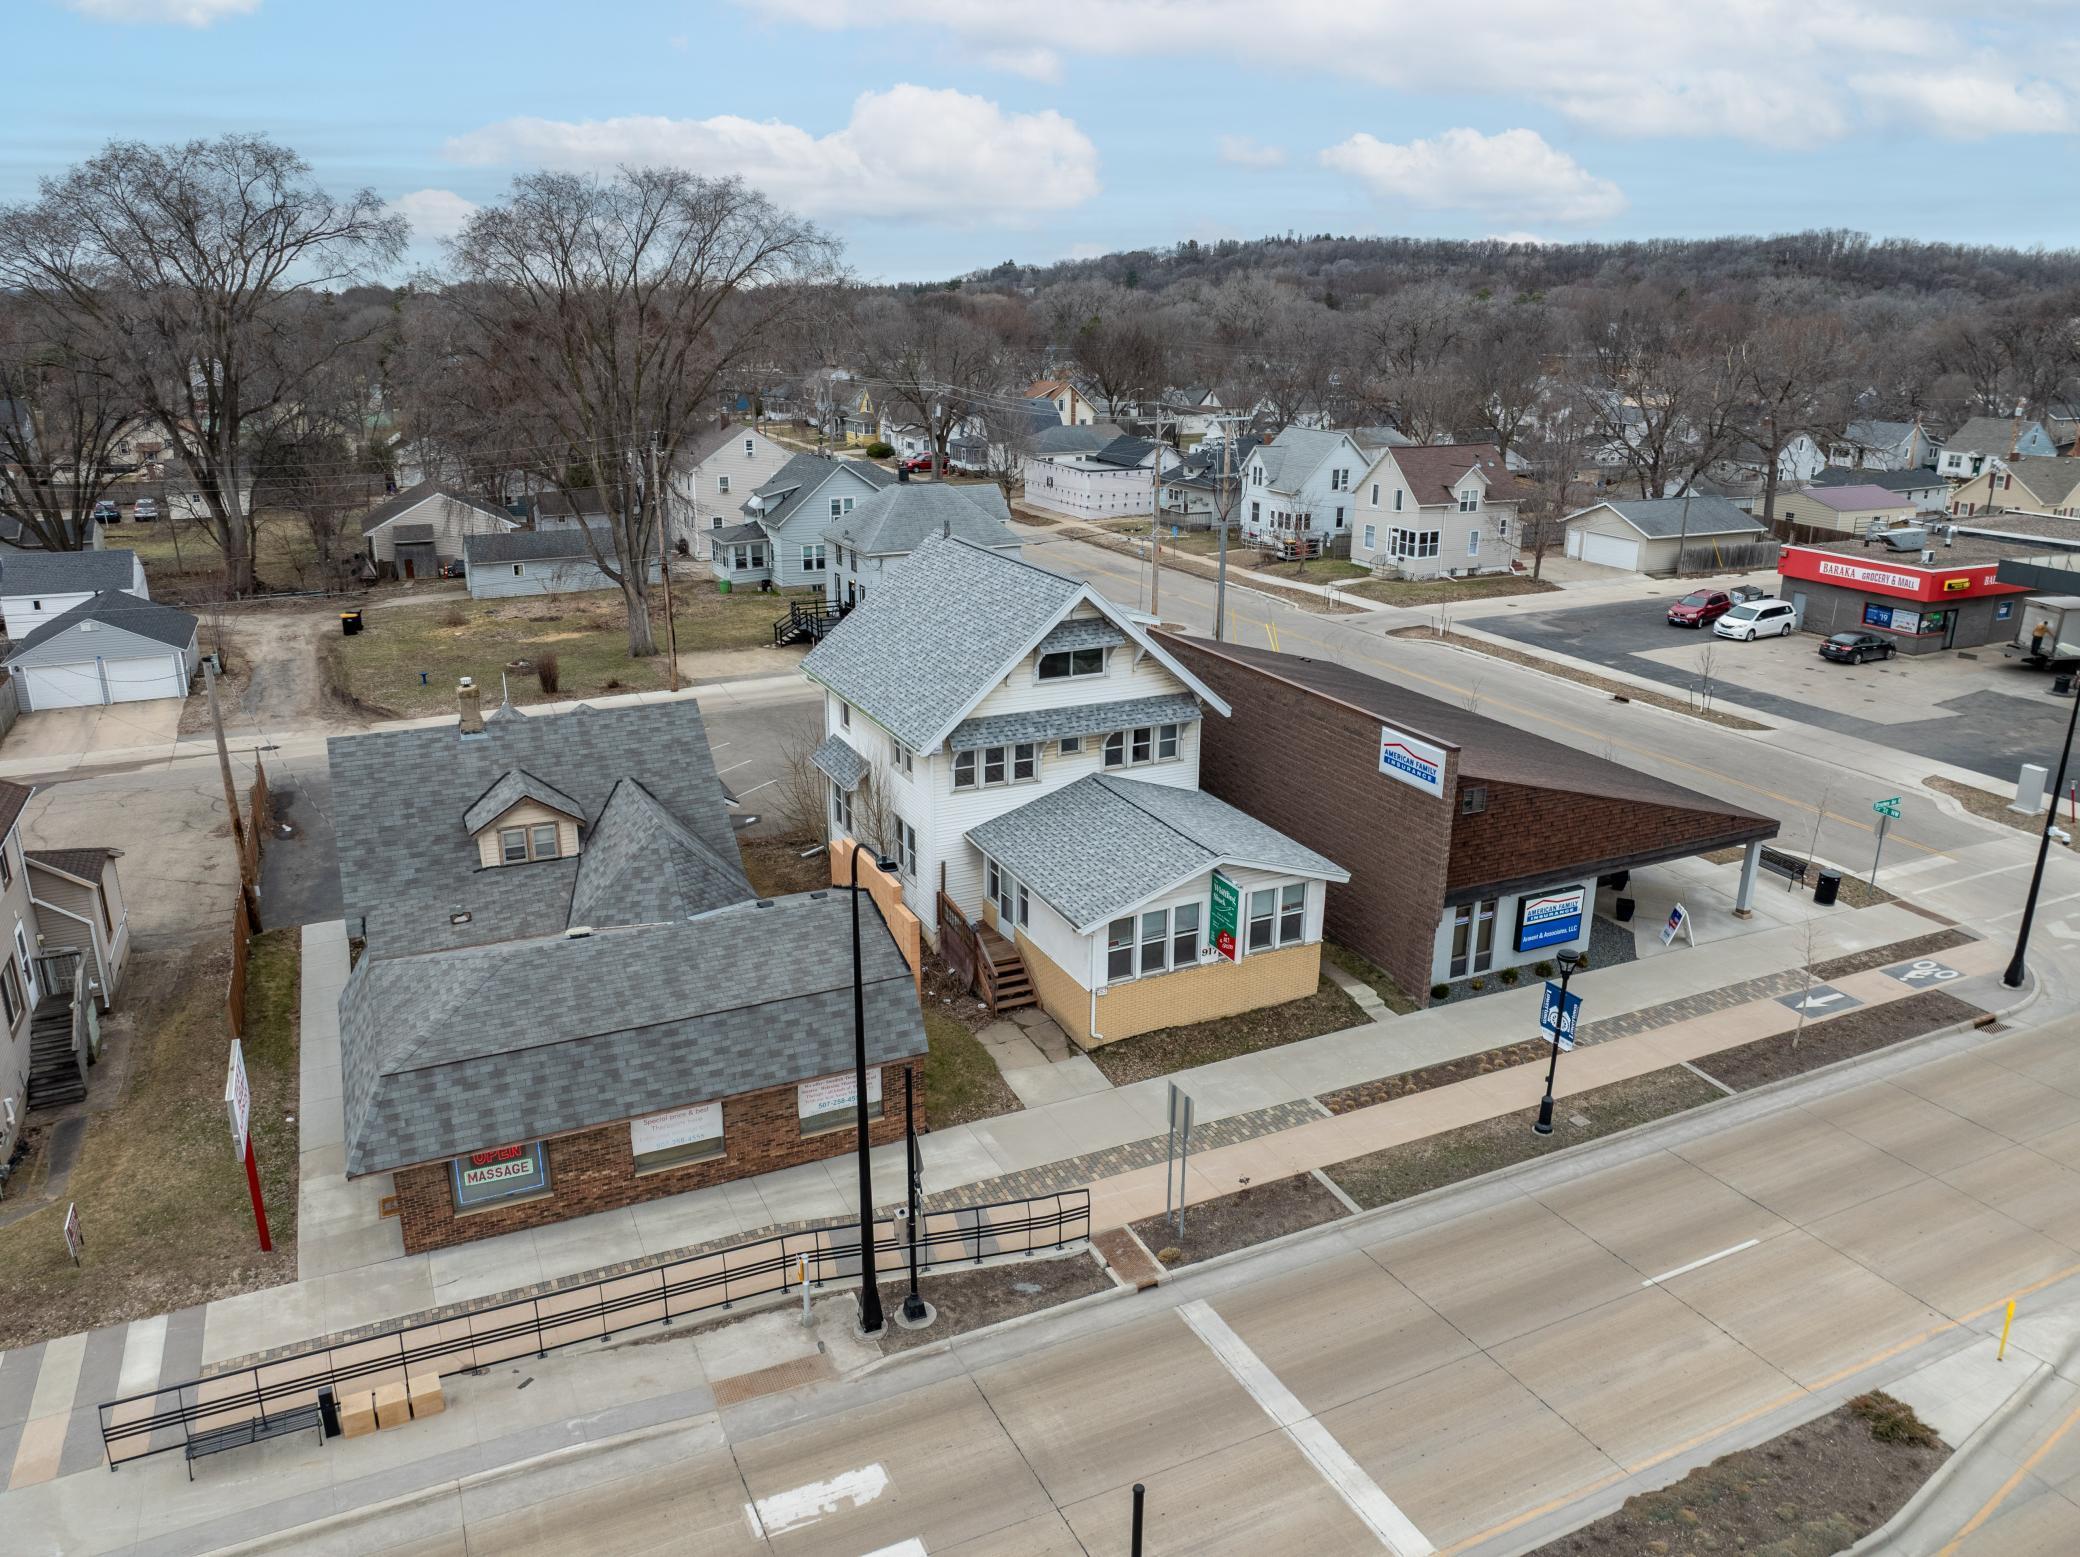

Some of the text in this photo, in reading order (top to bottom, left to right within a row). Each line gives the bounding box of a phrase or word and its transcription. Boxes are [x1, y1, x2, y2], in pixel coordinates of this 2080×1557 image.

[1822, 563, 1915, 589] BARAKA GROCERY & MALL
[1384, 748, 1437, 776] AMERICAN FAMILY
[1387, 758, 1433, 781] INSURANCE
[1527, 900, 1579, 916] AMERICAN FAMILY
[1530, 908, 1574, 921] INSURANCE
[1568, 925, 1578, 933] LLC
[818, 1095, 857, 1109] 507-258-45
[471, 1146, 522, 1166] OPEN
[467, 1161, 529, 1184] MASSAGE
